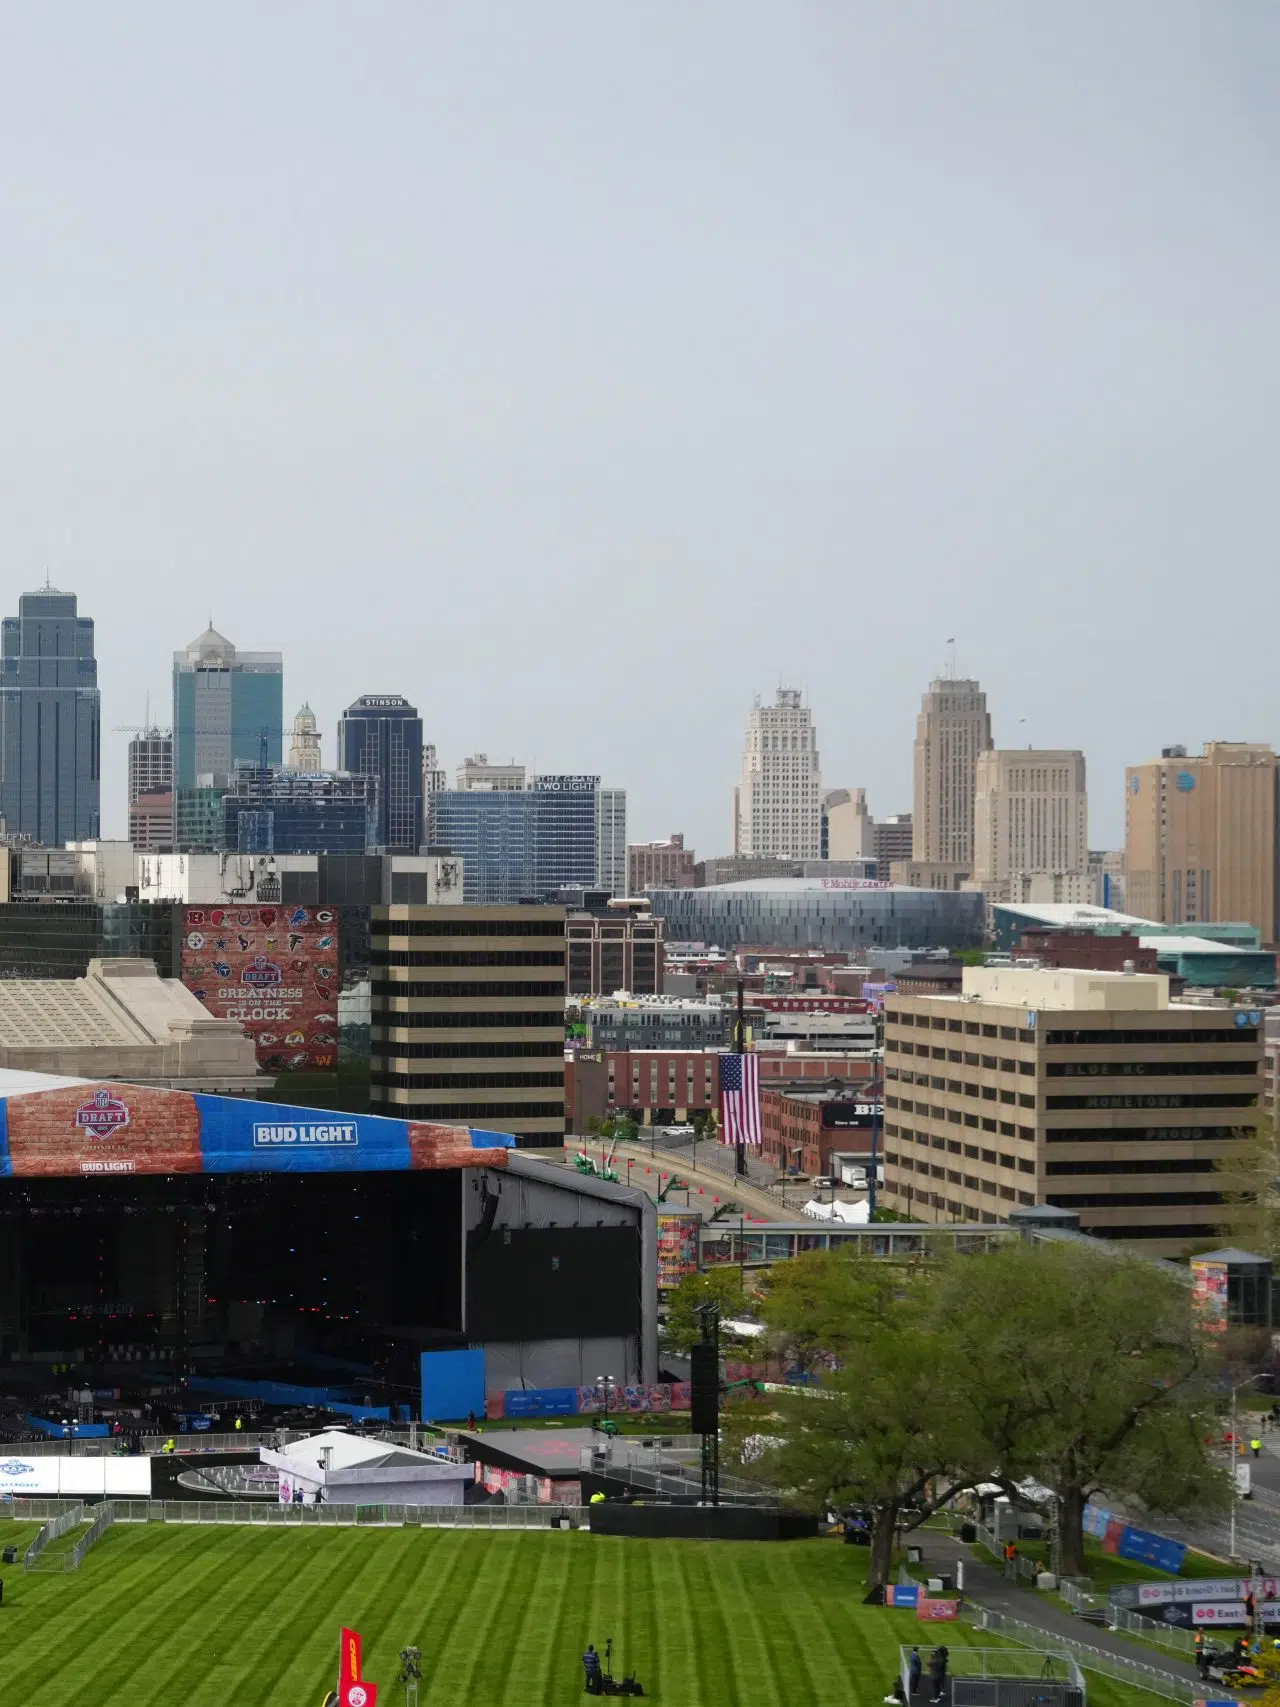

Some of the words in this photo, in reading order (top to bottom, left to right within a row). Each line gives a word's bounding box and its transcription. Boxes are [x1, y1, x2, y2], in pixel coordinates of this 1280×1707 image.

[537, 783, 560, 791] TWO
[563, 783, 592, 791] LIGHT
[245, 973, 276, 981] DRAFT
[218, 988, 303, 999] GREATNESS
[226, 1007, 290, 1020] CLOCK
[1087, 1096, 1182, 1109] HOMETOWN
[81, 1112, 123, 1122] DRAFT
[258, 1127, 298, 1142] BUD
[299, 1126, 354, 1142] LIGHT
[1146, 1128, 1203, 1140] PROUD
[81, 1163, 103, 1172] BUD
[104, 1162, 134, 1171] LIGHT
[1218, 1609, 1237, 1617] East
